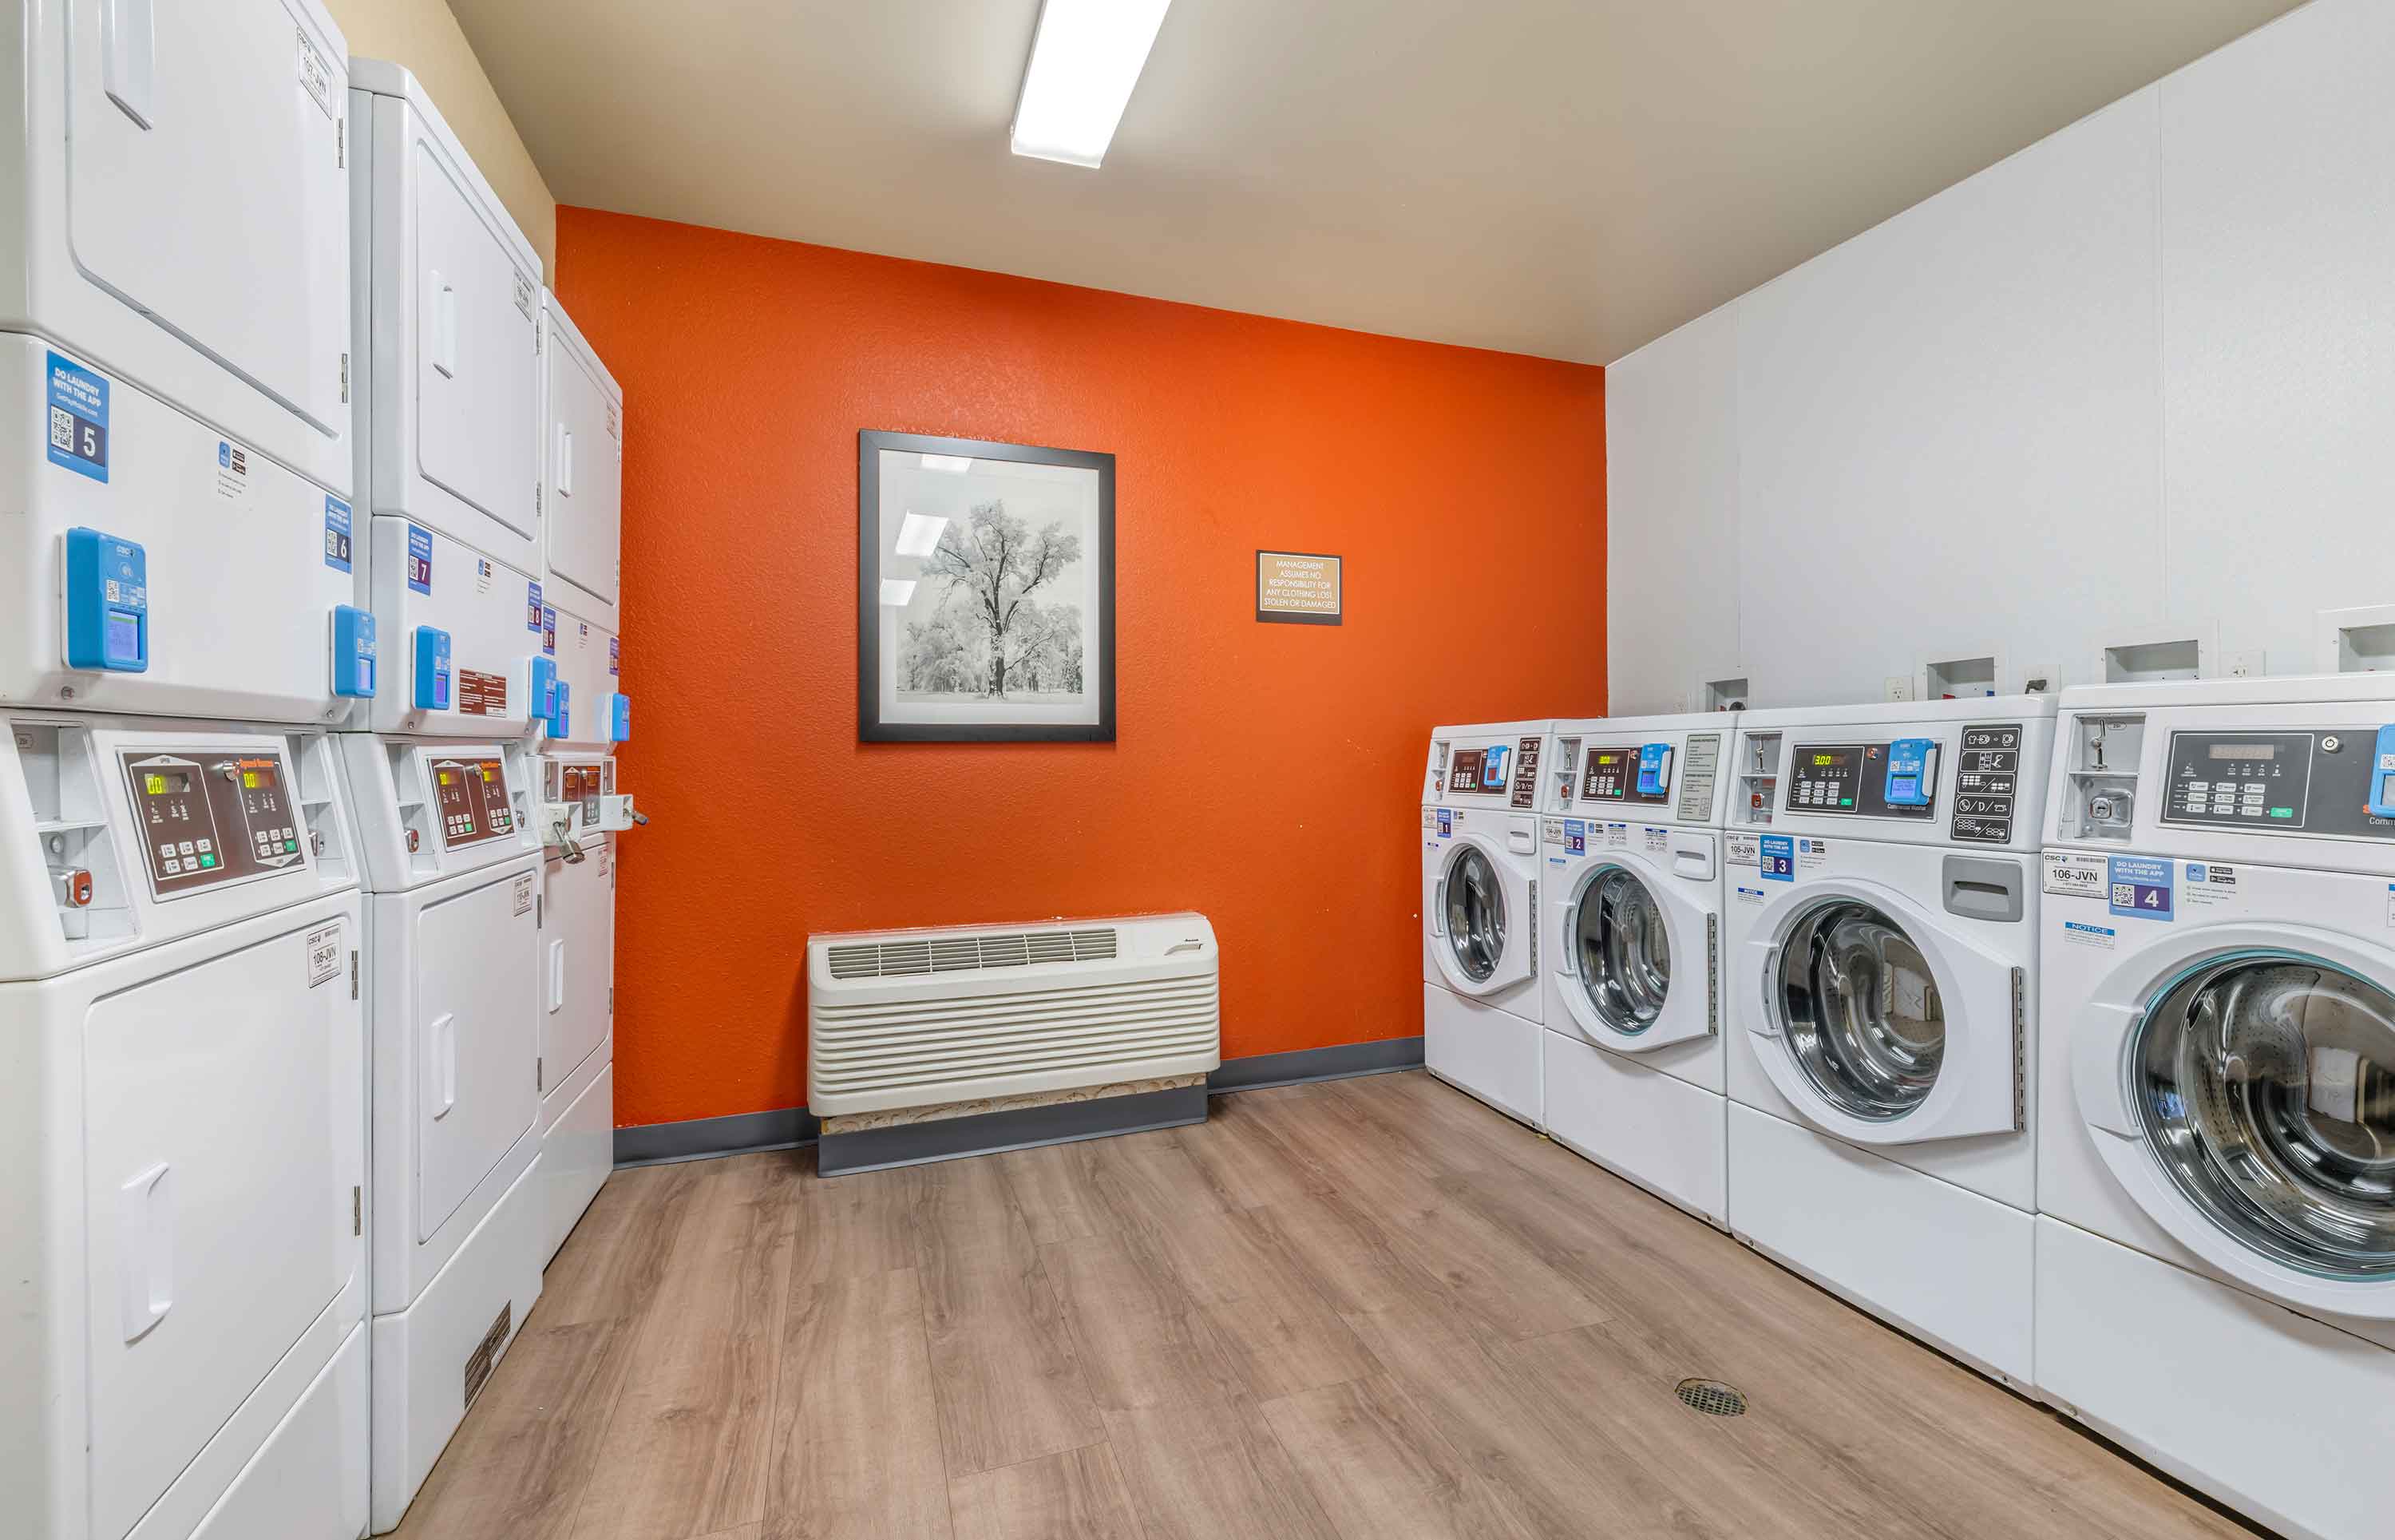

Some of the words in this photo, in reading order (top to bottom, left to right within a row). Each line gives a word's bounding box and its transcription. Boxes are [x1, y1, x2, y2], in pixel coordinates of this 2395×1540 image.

[54, 366, 66, 379] DO
[67, 372, 100, 397] LAUNDRY
[53, 377, 73, 394] WITH
[73, 387, 87, 402] THE
[88, 394, 101, 407] APP
[83, 426, 96, 457] 5
[340, 538, 347, 558] 6
[1277, 560, 1324, 569] MANAGEMENT
[421, 563, 428, 582] 7
[1279, 569, 1308, 579] ASSUMES
[1269, 578, 1317, 588] RESPONSIBILITY
[1281, 590, 1316, 599] CLOTHING
[1264, 598, 1289, 607] STOLEN
[1301, 600, 1336, 609] DAMAGED
[536, 608, 540, 624] 8
[1445, 824, 1448, 833] 1
[1575, 838, 1581, 849] 2
[1731, 845, 1756, 854] 105-JVN
[1779, 860, 1787, 873] 3
[2052, 869, 2098, 882] 106-JVN
[2144, 889, 2159, 907] 4
[2072, 923, 2108, 935] NOTICE
[313, 945, 336, 964] 108-JVN
